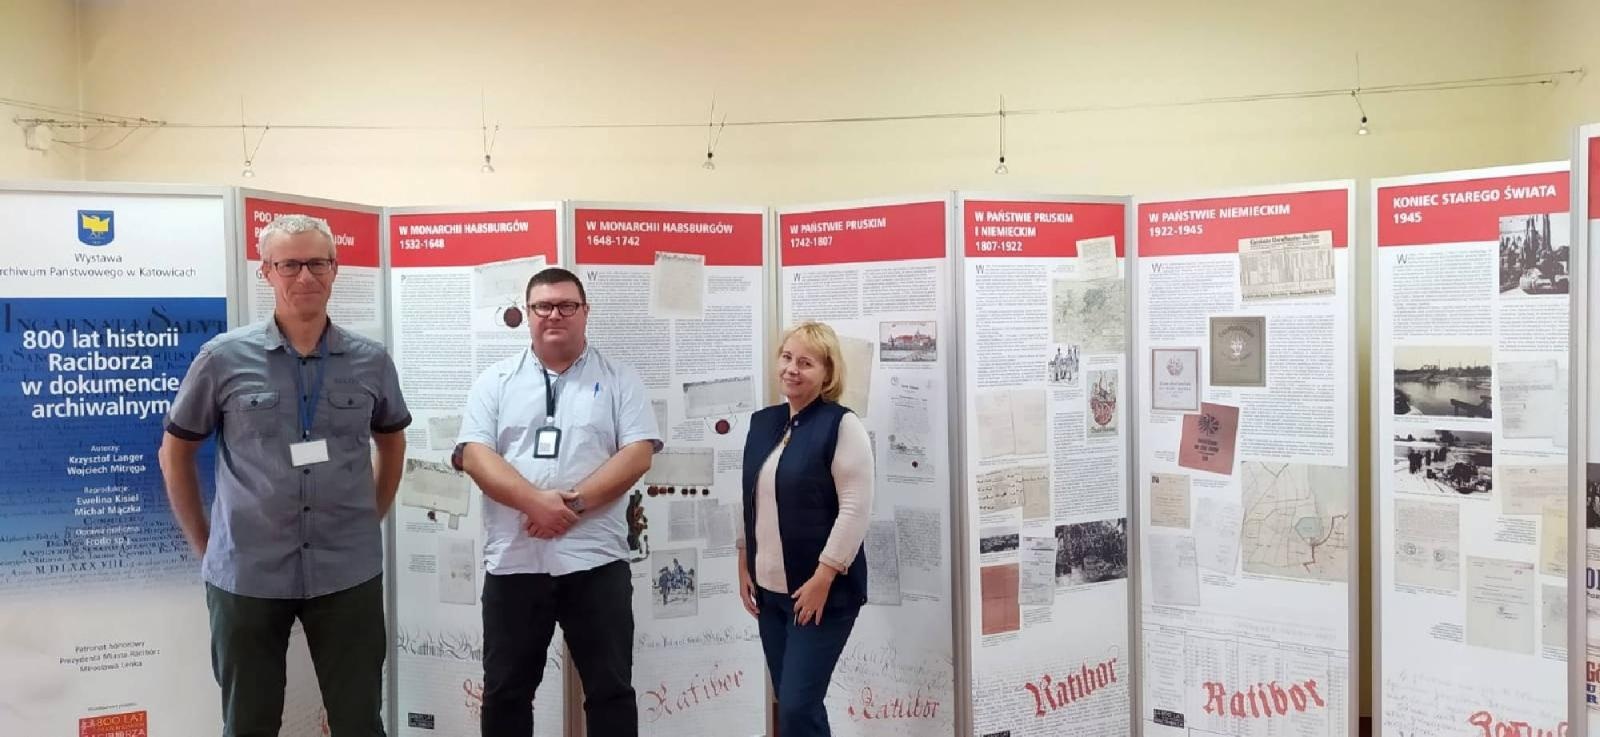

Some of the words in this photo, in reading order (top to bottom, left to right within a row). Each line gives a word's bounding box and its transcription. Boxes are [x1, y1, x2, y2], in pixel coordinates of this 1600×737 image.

[1393, 195, 1439, 208] KONIEC
[1442, 189, 1500, 206] STAREGO
[1504, 184, 1556, 201] ŚWIATA
[975, 212, 984, 222] W
[986, 210, 1032, 222] PAŃSTWIE
[1034, 211, 1074, 223] PRUSKIM
[1149, 213, 1159, 223] W
[1162, 208, 1216, 222] PAŃSTWIE
[1219, 204, 1291, 219] NIEMIECKIM
[1394, 211, 1422, 224] 1945
[399, 226, 409, 236] W
[411, 223, 462, 235] MONARCHII
[464, 218, 529, 233] HABSBURGÓW
[586, 221, 597, 231] W
[600, 221, 660, 232] MONARCHII
[662, 220, 733, 234] HABSBURGÓW
[790, 224, 799, 235] W
[801, 220, 843, 233] PAŃSTWIE
[845, 217, 887, 230] PRUSKIM
[974, 226, 979, 237] I
[981, 226, 1036, 238] NIEMIECKIM
[1149, 225, 1203, 237] 1922-1945
[399, 238, 445, 250] 1532-1648
[586, 235, 640, 247] 1648-1742
[790, 236, 833, 249] 1742-1807
[975, 241, 1023, 252] 1807-1922
[74, 253, 122, 264] Wystawa
[0, 266, 46, 276] rchiwum
[50, 266, 123, 278] Państwowego
[139, 267, 196, 277] Katowicach
[22, 330, 65, 350] 800
[72, 329, 100, 349] lat
[106, 328, 179, 348] historii
[48, 352, 153, 371] Raciborza
[21, 381, 42, 395] w
[49, 373, 180, 395] dokumencie
[31, 396, 169, 421] archiwalnym
[69, 453, 111, 466] Krzysztof
[113, 453, 144, 464] Langer
[67, 466, 108, 476] Wojciech
[76, 496, 112, 506] Ewelina
[115, 494, 139, 503] Kisiel
[1203, 679, 1325, 718] Ratibor
[96, 716, 121, 727] 800
[123, 713, 145, 724] LAT
